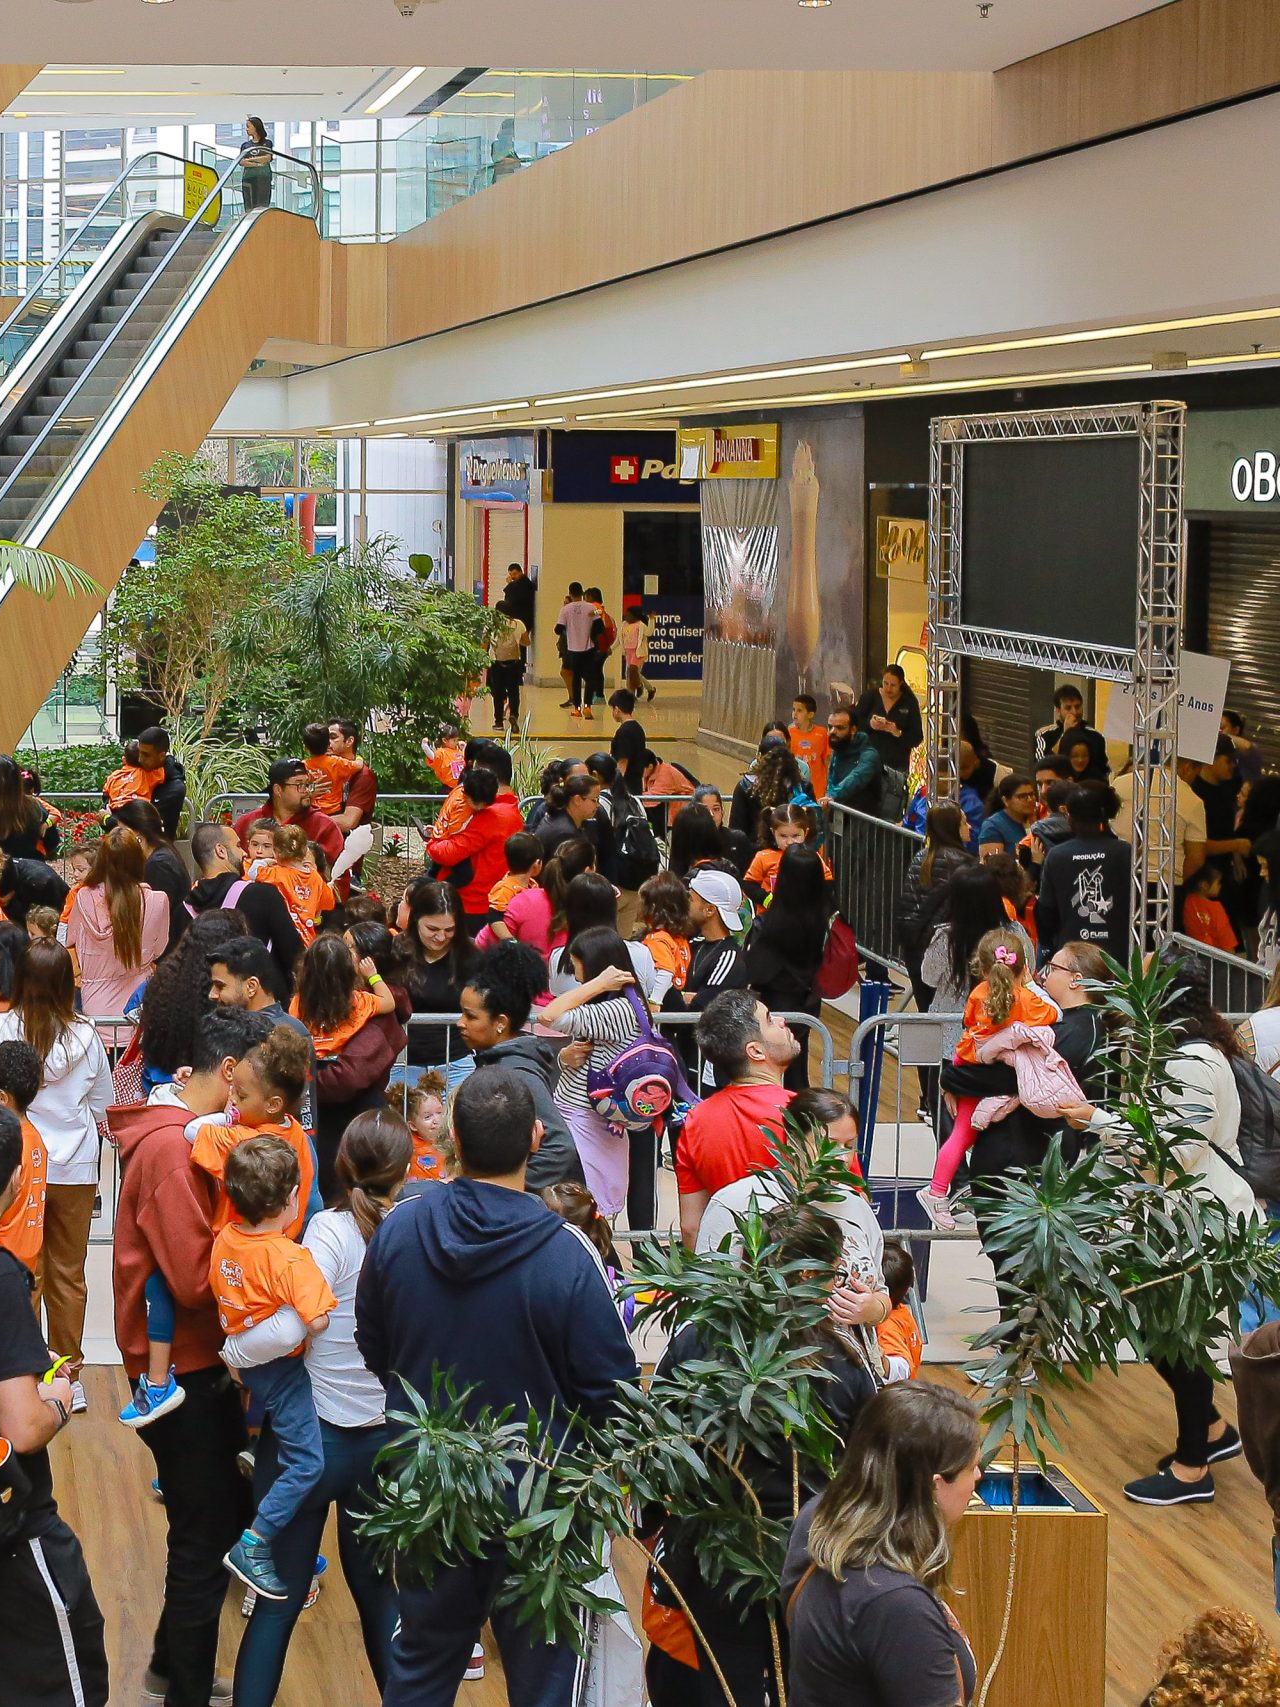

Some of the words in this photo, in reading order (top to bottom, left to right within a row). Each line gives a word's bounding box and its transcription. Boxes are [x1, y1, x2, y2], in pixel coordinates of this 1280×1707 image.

[715, 438, 753, 463] HAVANNA
[1231, 449, 1280, 503] oB
[1187, 696, 1214, 713] Anos
[1072, 852, 1106, 861] PRODUÇÃO
